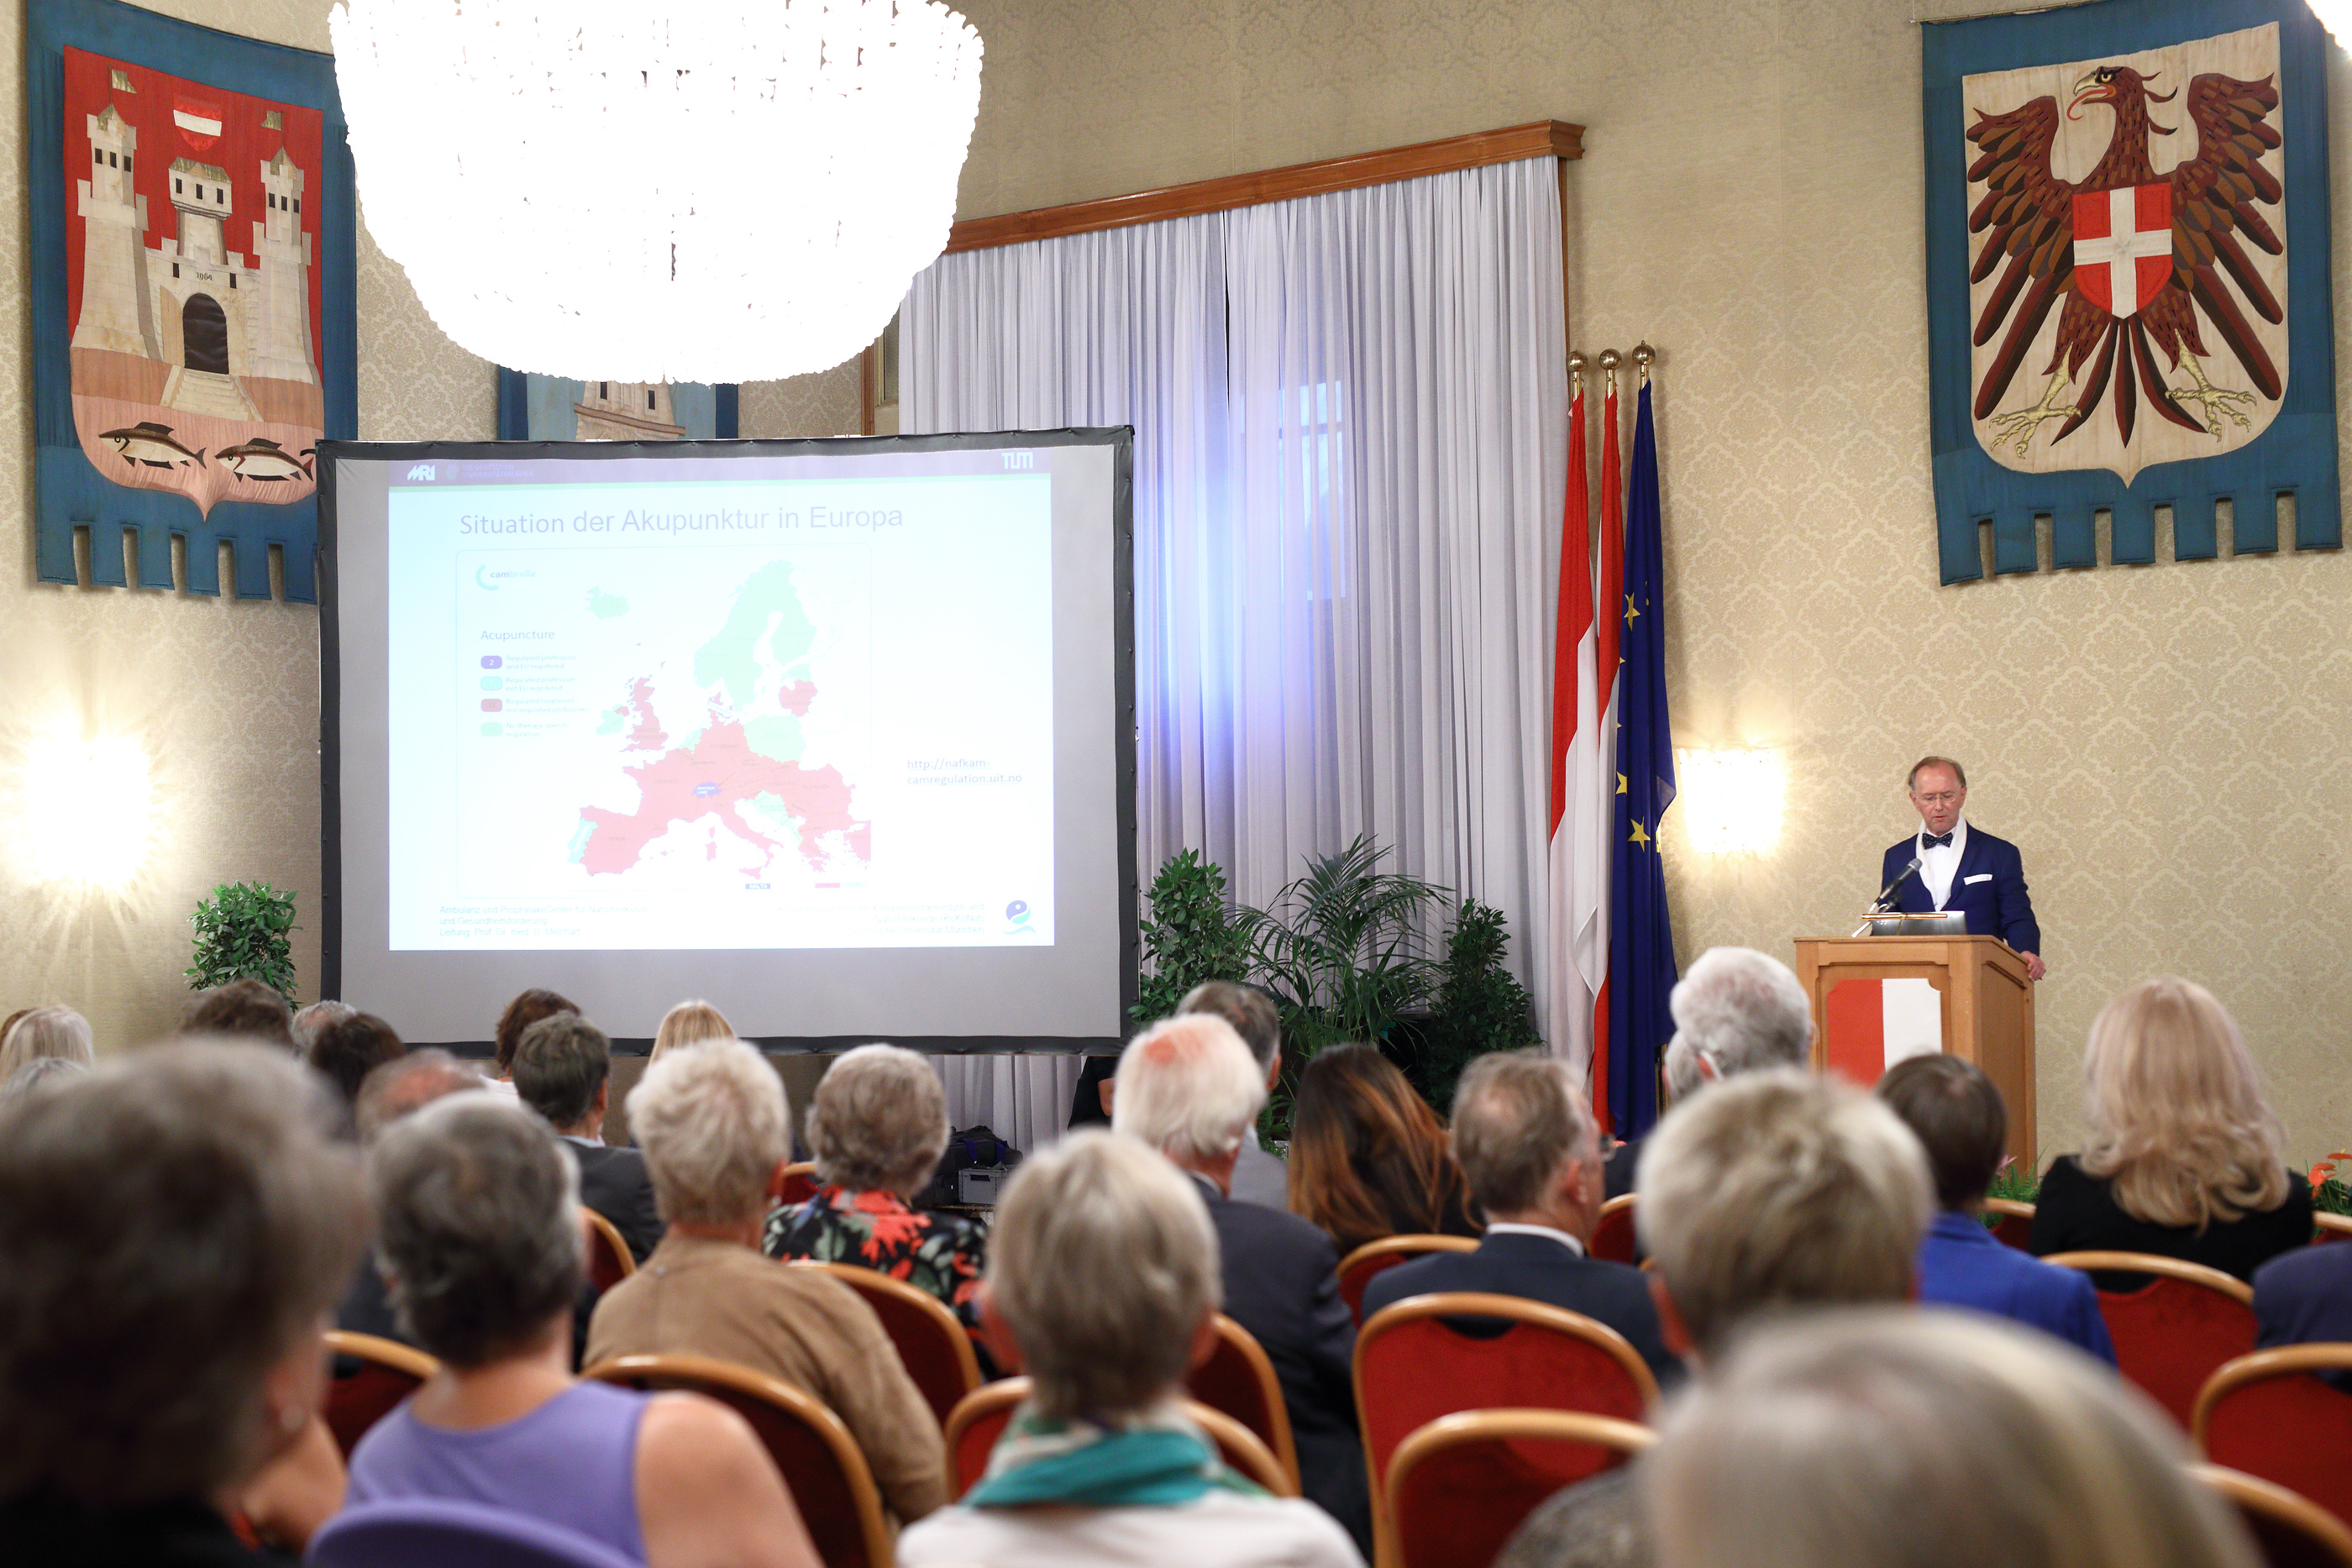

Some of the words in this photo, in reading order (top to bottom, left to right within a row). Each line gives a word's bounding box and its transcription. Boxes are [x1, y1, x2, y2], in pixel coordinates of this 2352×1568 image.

[1001, 452, 1033, 469] TUM
[407, 464, 435, 480] MRI
[459, 513, 564, 534] Situation
[572, 510, 615, 532] der
[621, 507, 769, 536] Akupunktur
[778, 506, 799, 529] in
[810, 506, 904, 532] Europa
[490, 569, 536, 578] cambrella
[480, 630, 555, 642] Acupuncture
[907, 758, 990, 771] http://nafkam-
[907, 773, 1022, 786] camregulation.uit.no
[438, 905, 480, 914] Ambulanz
[482, 905, 498, 914] und
